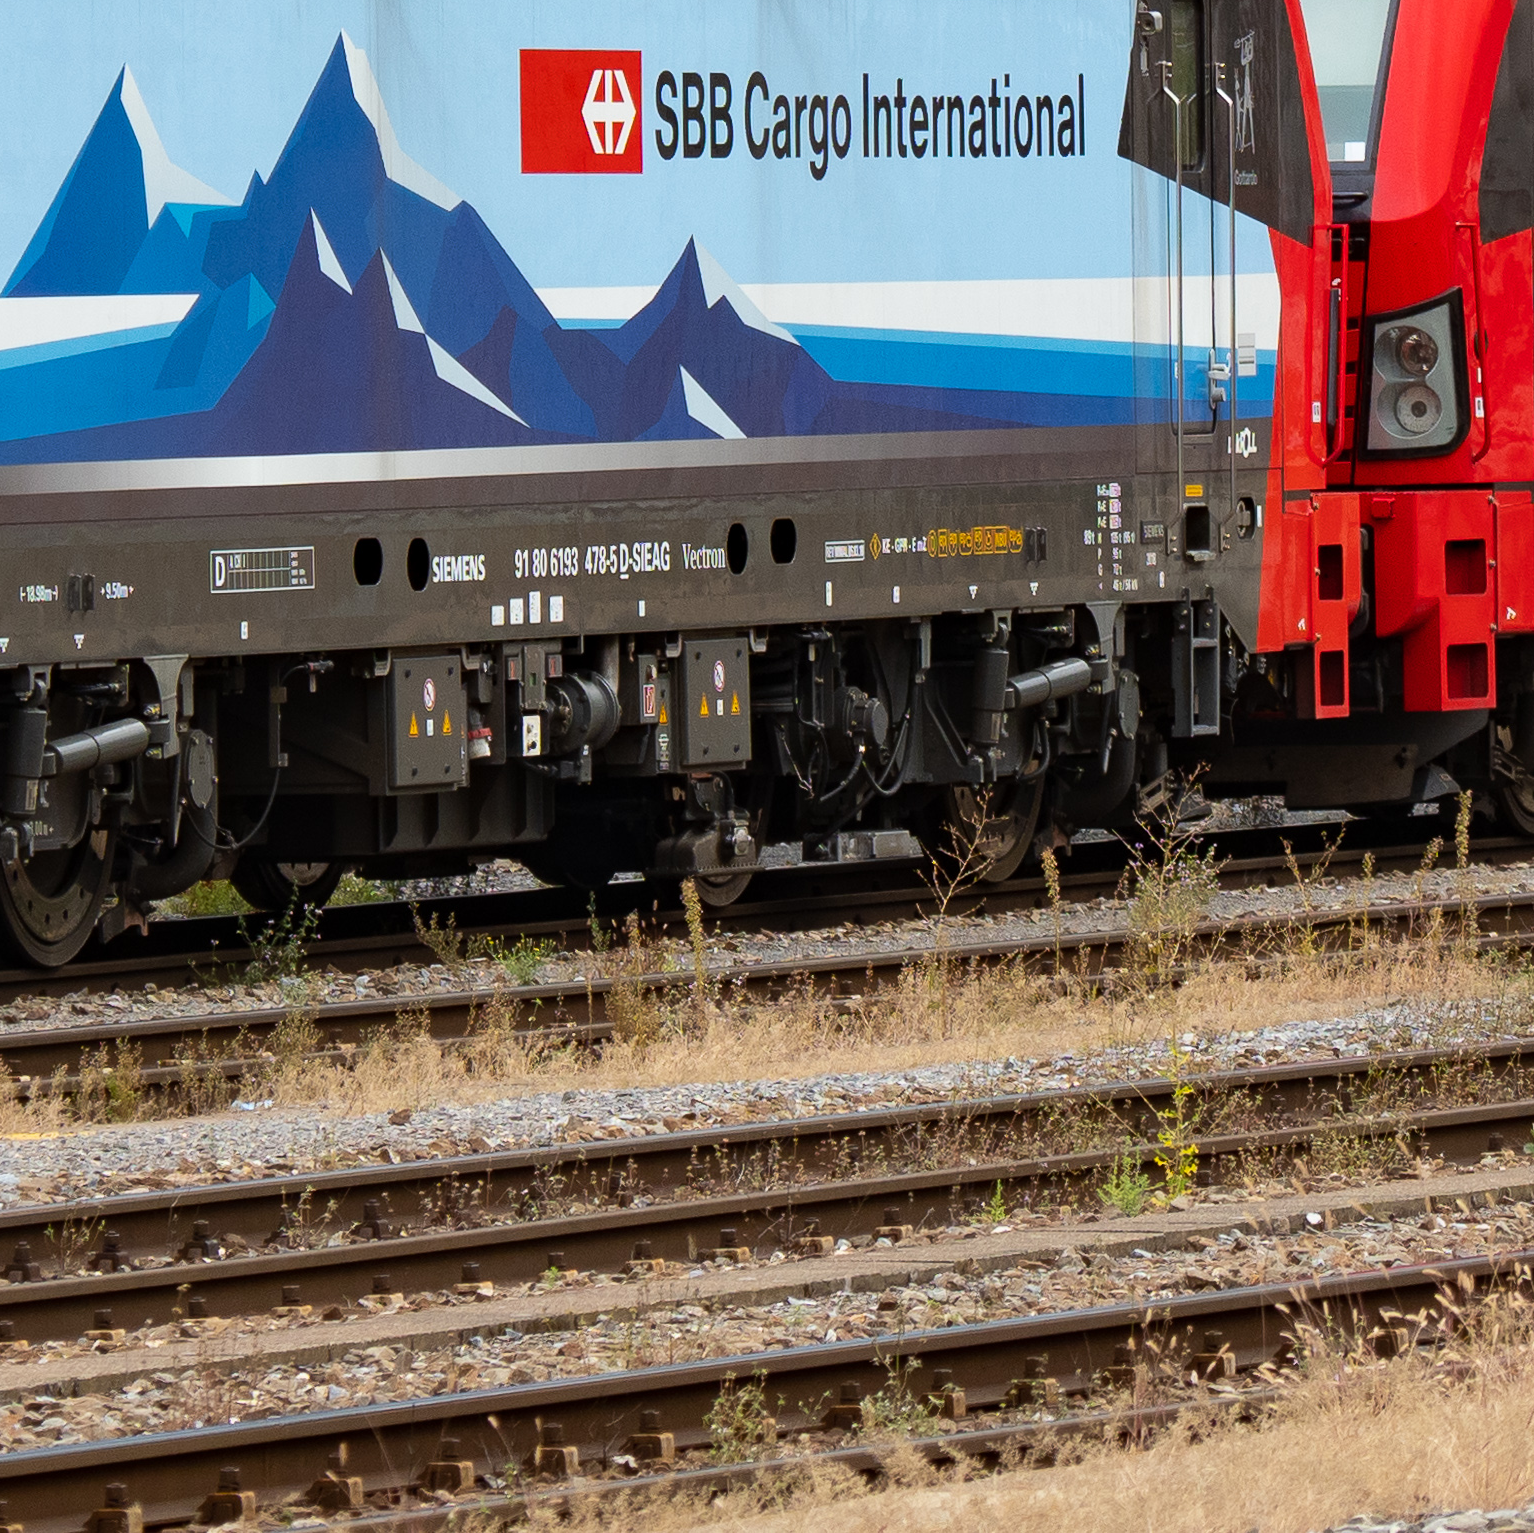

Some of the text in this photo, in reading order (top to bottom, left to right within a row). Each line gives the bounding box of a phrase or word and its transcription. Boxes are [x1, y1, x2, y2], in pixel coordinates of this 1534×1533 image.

[654, 70, 1085, 181] SBB Cargo International
[215, 556, 225, 586] D
[432, 541, 726, 583] SIEMENS 91 80 6193 478-5 D-SIEAG Vectron
